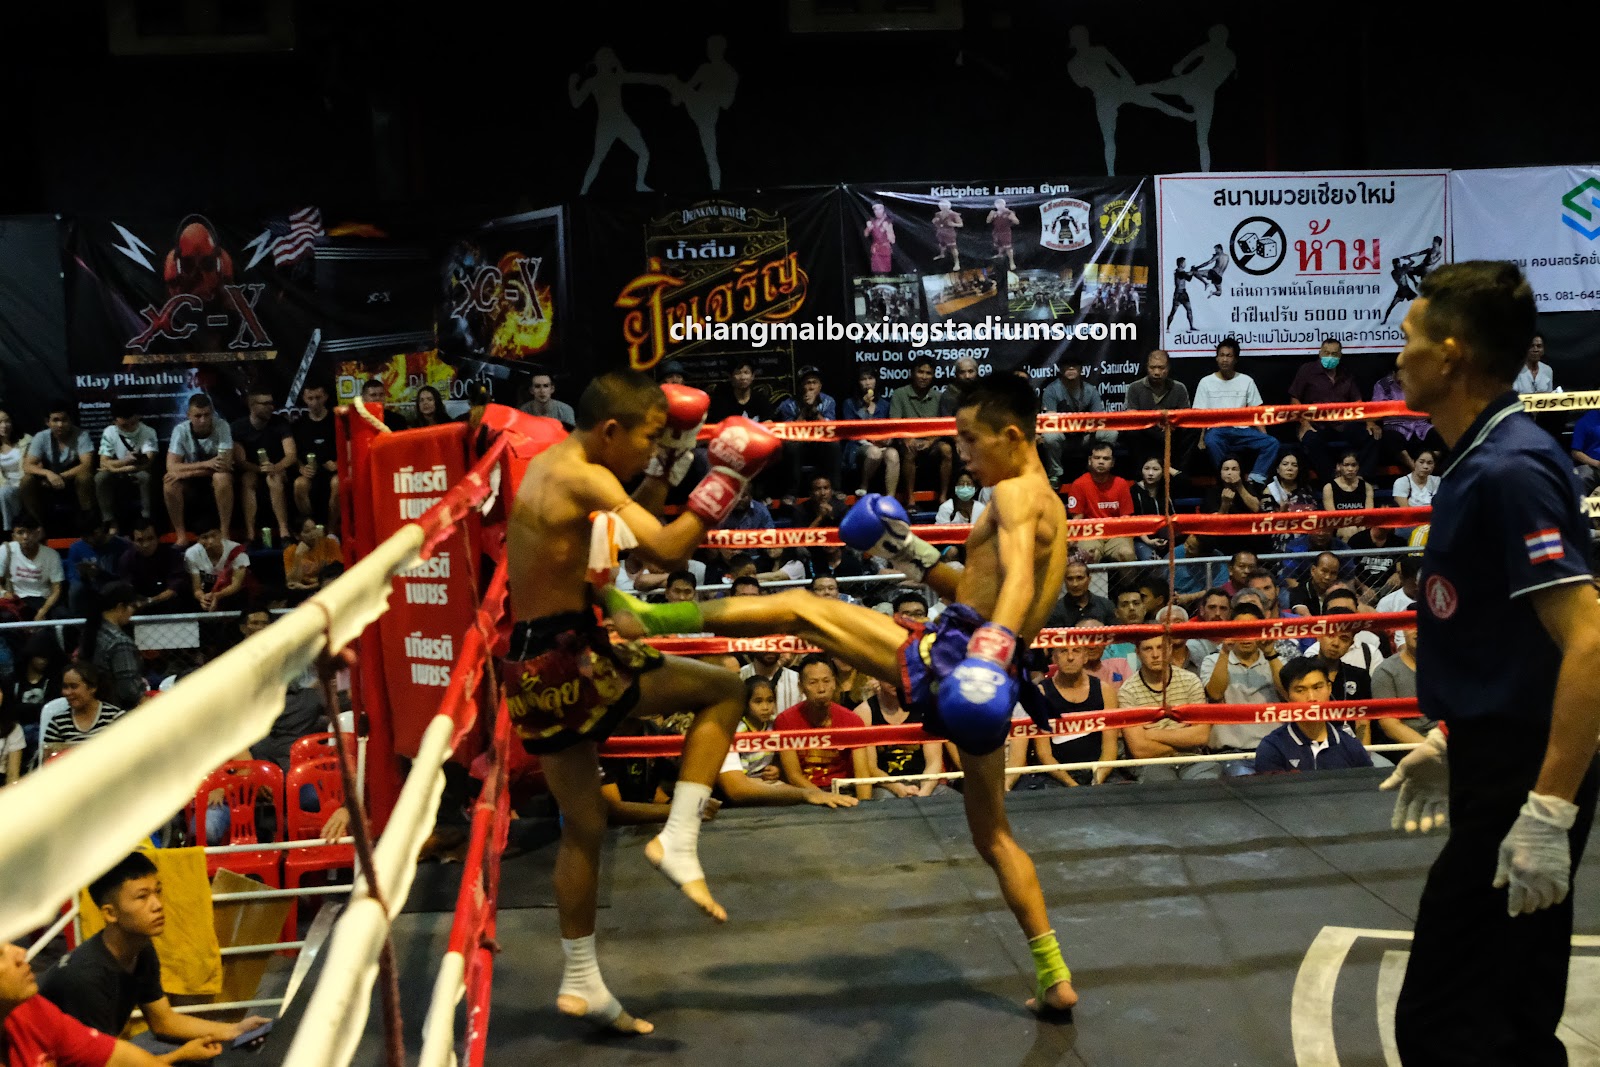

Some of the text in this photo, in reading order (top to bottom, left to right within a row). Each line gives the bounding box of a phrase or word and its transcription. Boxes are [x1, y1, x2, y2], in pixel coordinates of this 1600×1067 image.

[930, 183, 1070, 198] Kiatphet Lanna Gym
[1213, 181, 1396, 206] สนามมวยเชียงใหม่
[720, 205, 747, 223] WATER
[665, 239, 737, 260] น้ำดื่ม
[1294, 219, 1381, 271] ห้าม
[1230, 281, 1381, 298] เล่นการพนันโดยเด็ดขาด
[1231, 306, 1382, 323] ฝ่าฝืนปรับ 5000 บาท
[1100, 360, 1140, 376] Saturday
[75, 374, 110, 390] Klay
[405, 583, 448, 605] เพชร
